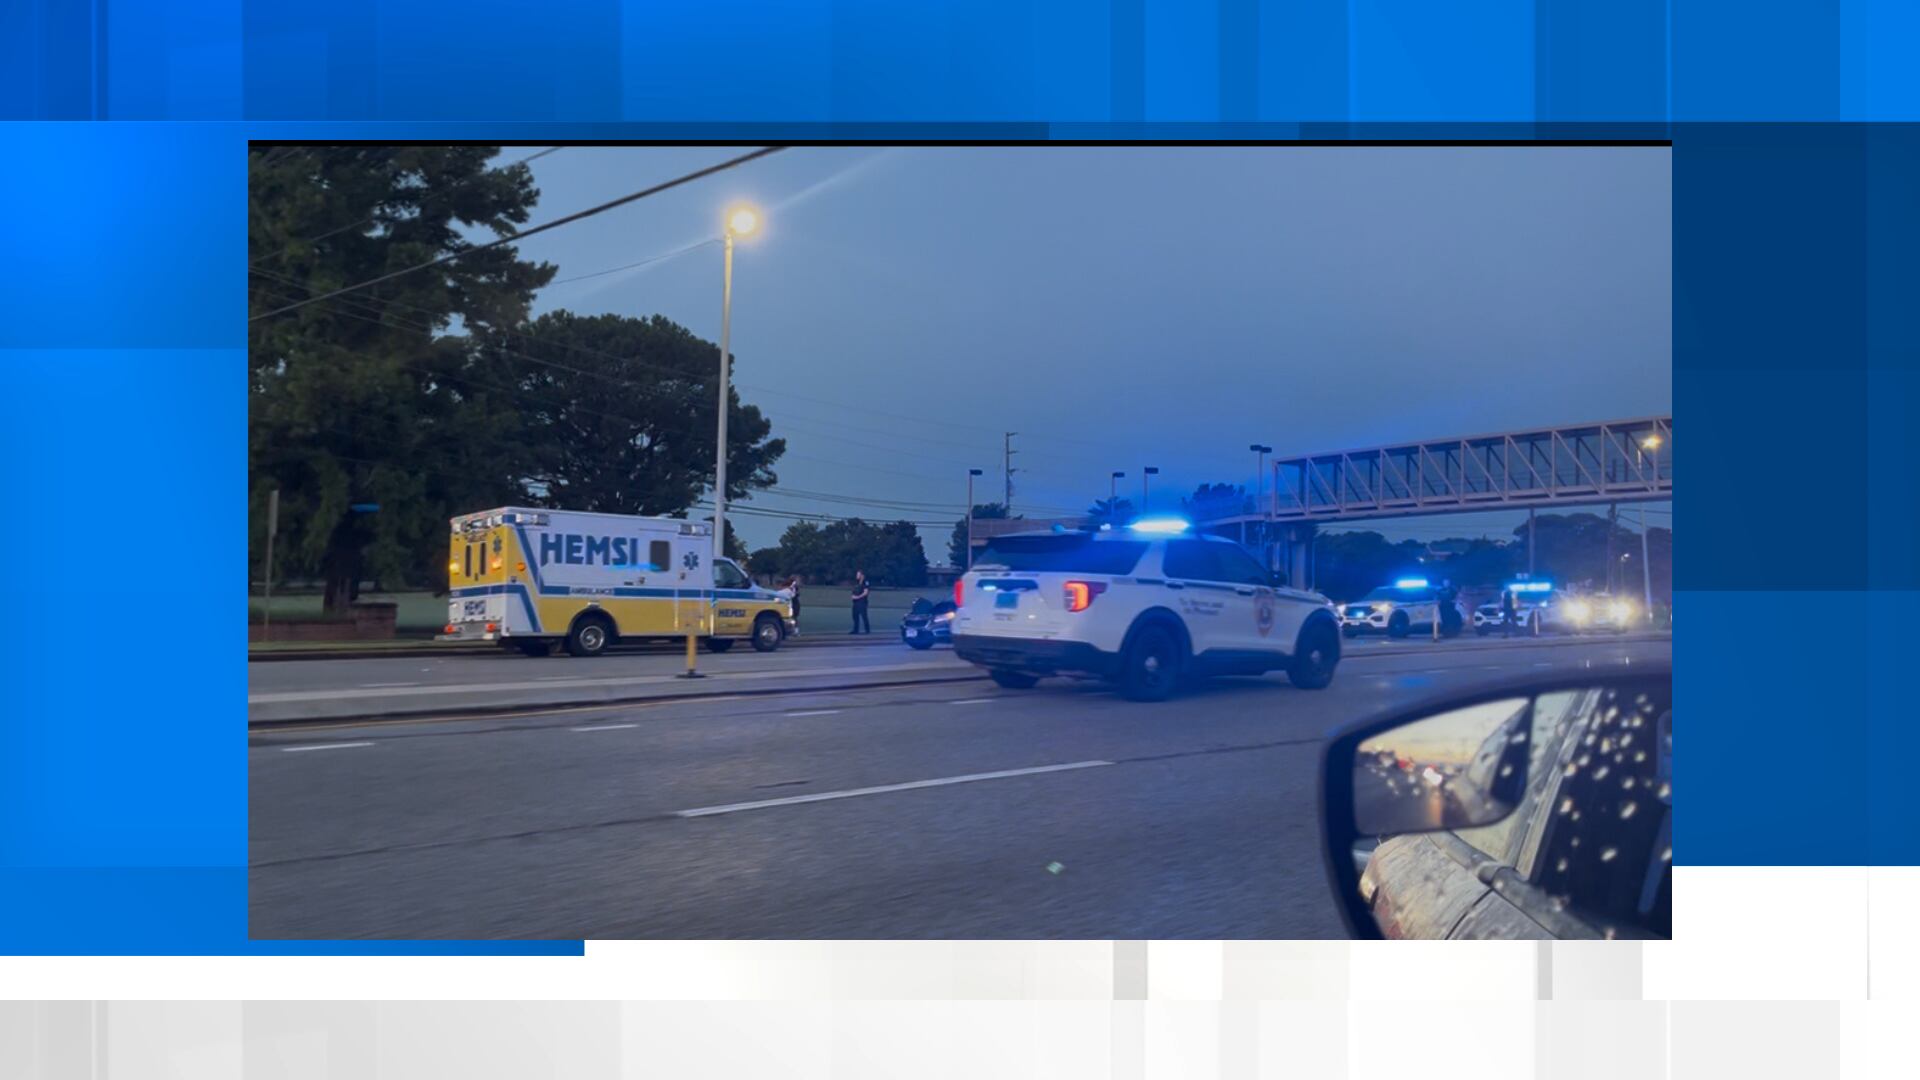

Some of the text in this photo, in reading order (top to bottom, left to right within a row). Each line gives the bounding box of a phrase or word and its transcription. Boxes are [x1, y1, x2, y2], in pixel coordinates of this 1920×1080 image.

[540, 532, 639, 566] HEMSI
[570, 586, 614, 596] AMBULANCE
[718, 608, 746, 618] HEMSI
